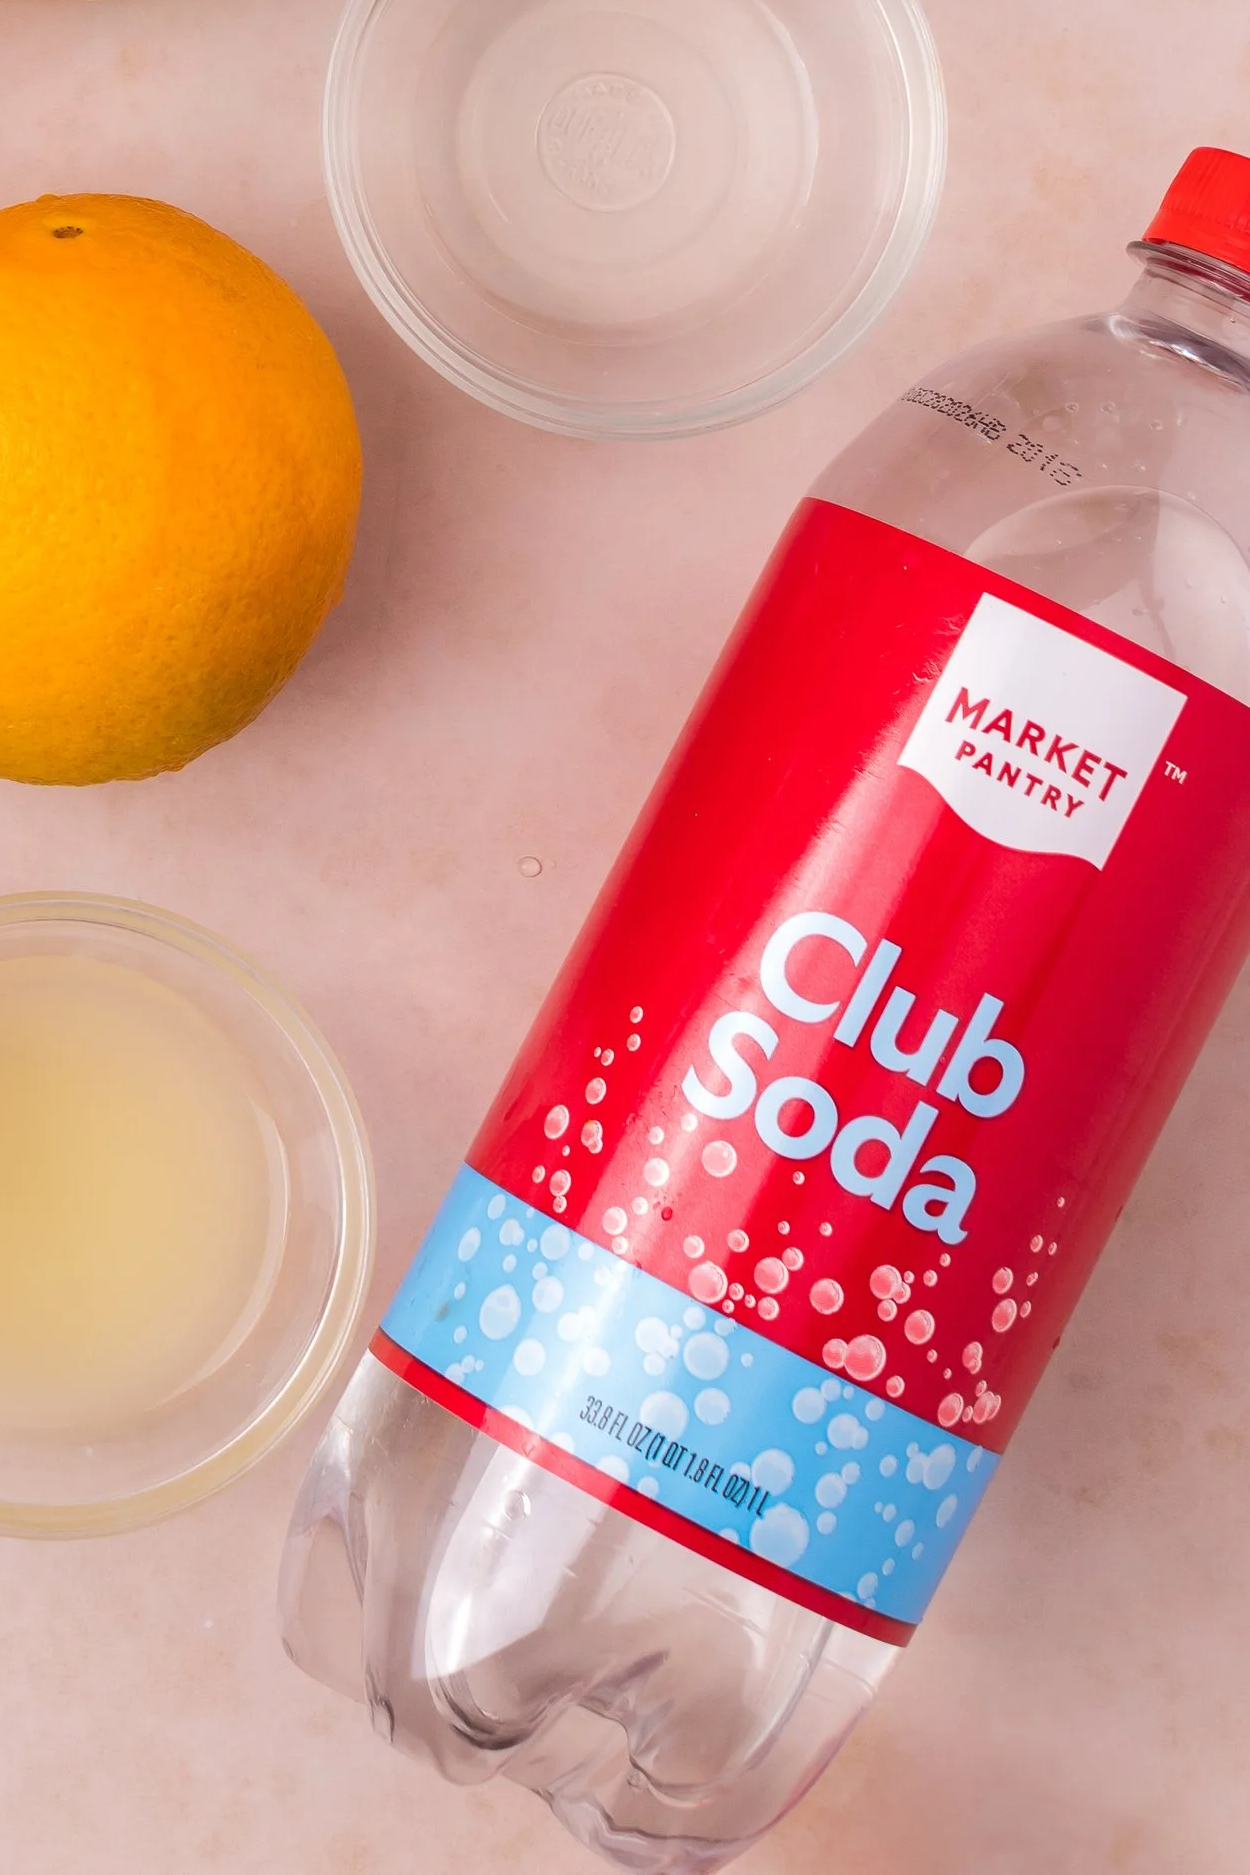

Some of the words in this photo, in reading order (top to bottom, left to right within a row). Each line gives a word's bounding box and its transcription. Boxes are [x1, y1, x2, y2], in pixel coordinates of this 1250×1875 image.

[945, 686, 1128, 803] MARKET
[954, 740, 1085, 819] PANTRY
[760, 911, 1025, 1119] Club
[681, 1011, 978, 1246] Soda
[579, 1395, 614, 1431] 33.8
[608, 1410, 629, 1441] FL
[627, 1422, 652, 1453] OZ
[661, 1441, 689, 1471] QT
[683, 1452, 710, 1483] 1.8
[704, 1464, 725, 1494] FL
[722, 1474, 751, 1509] OZ)
